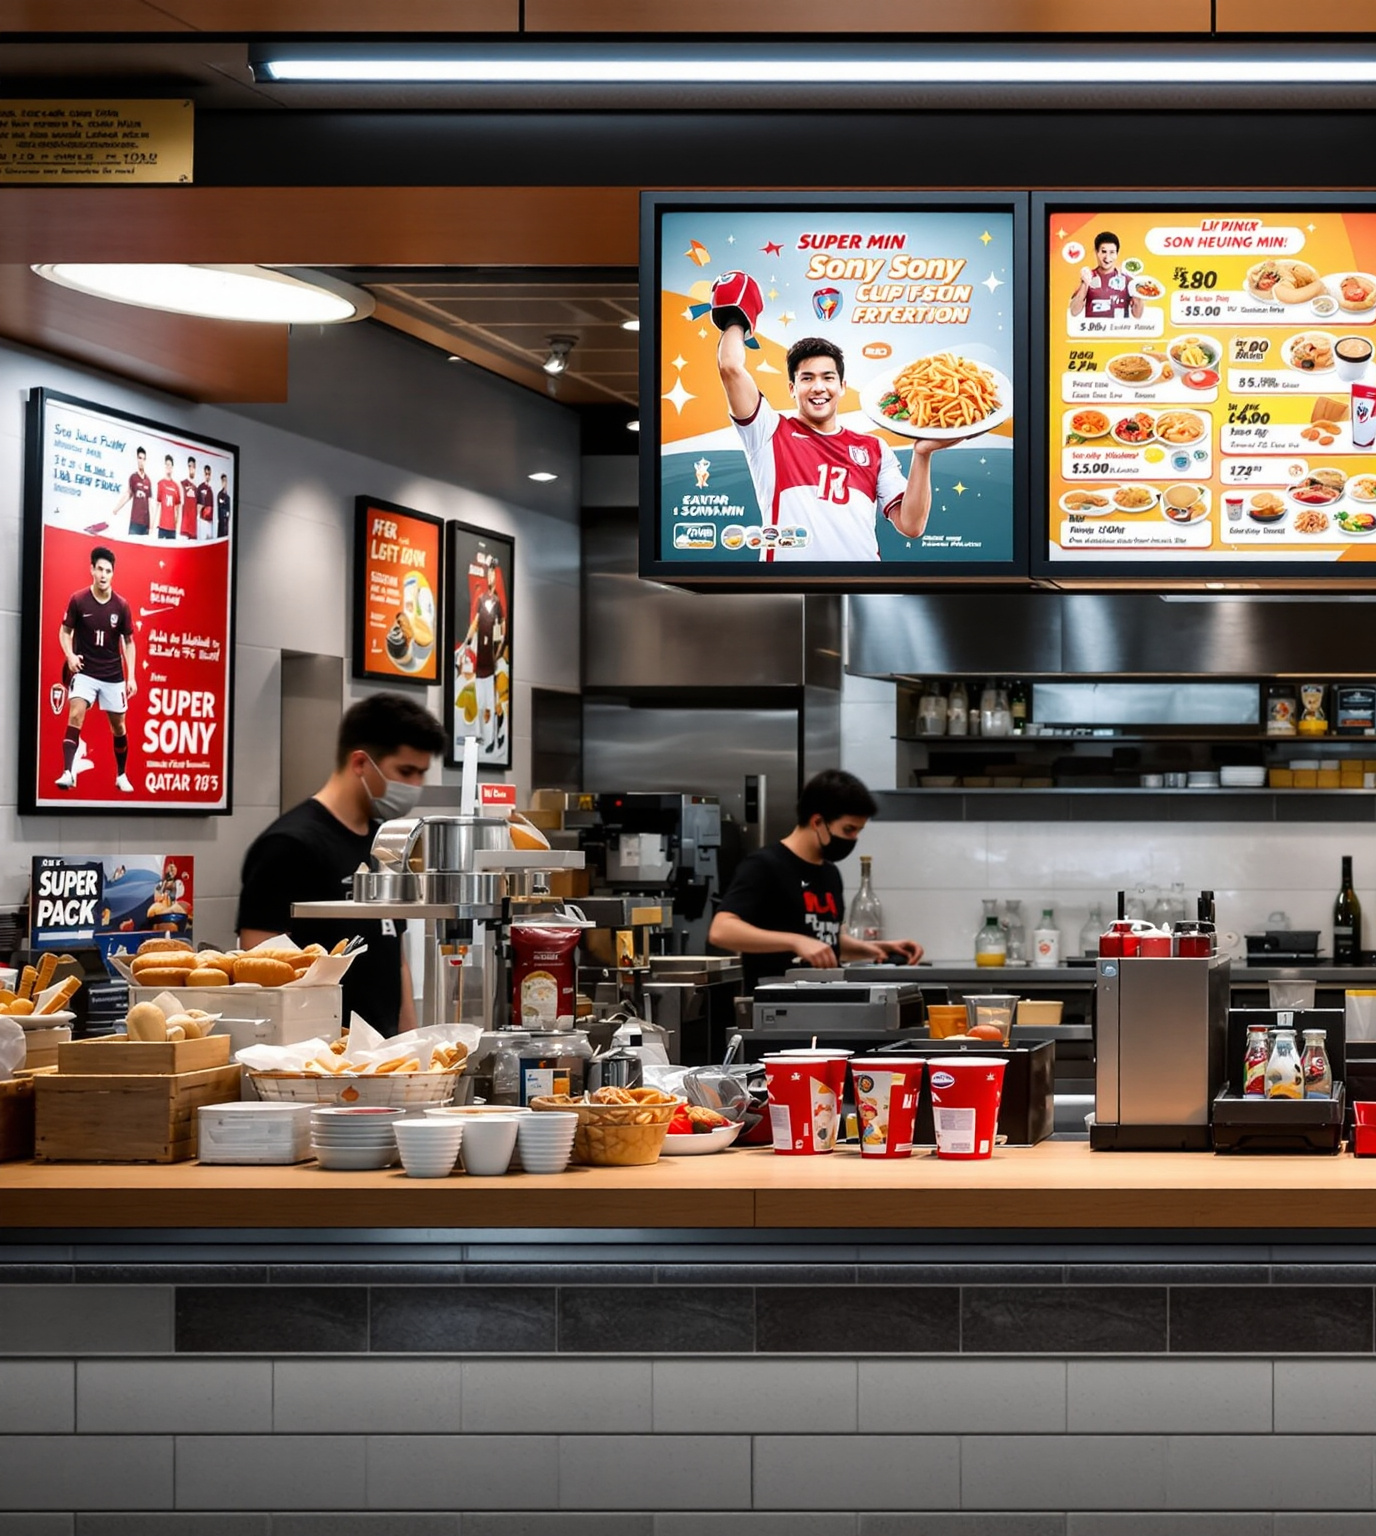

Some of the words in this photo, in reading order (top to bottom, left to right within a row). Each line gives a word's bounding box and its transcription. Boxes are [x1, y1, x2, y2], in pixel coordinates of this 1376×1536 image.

[797, 234, 863, 250] SUPER
[866, 234, 906, 250] MIN
[1163, 236, 1194, 248] SON
[805, 253, 886, 285] Sony
[887, 253, 967, 285] Sony
[147, 688, 215, 718] SUPER
[142, 719, 216, 755] SONY
[145, 772, 190, 793] QATAR
[38, 870, 98, 897] SUPER
[37, 899, 98, 927] PACK
